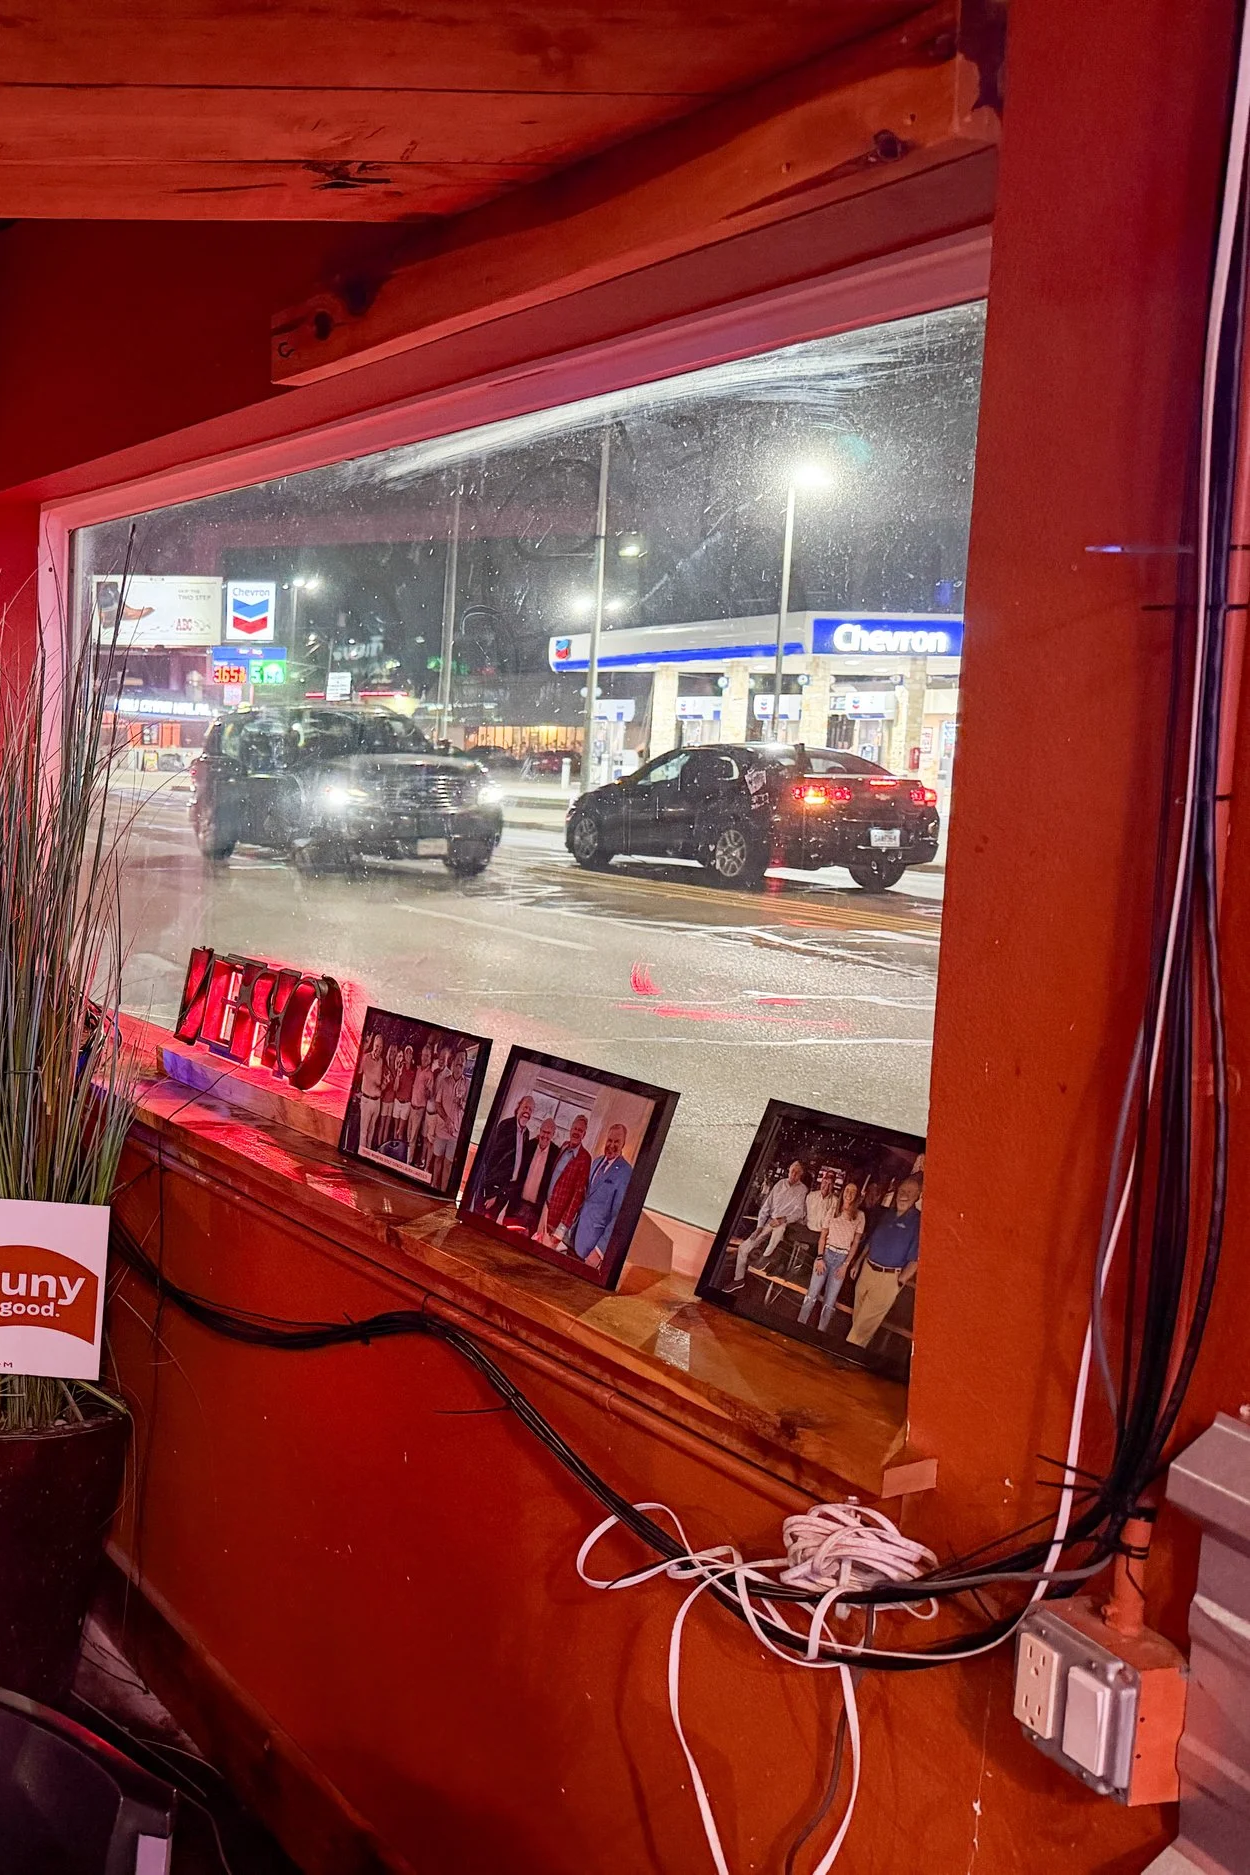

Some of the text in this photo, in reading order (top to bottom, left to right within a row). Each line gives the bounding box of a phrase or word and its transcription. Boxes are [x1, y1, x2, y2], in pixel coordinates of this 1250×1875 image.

[232, 587, 270, 597] Chevron
[833, 623, 948, 653] Chevron
[0, 1301, 61, 1318] good.
